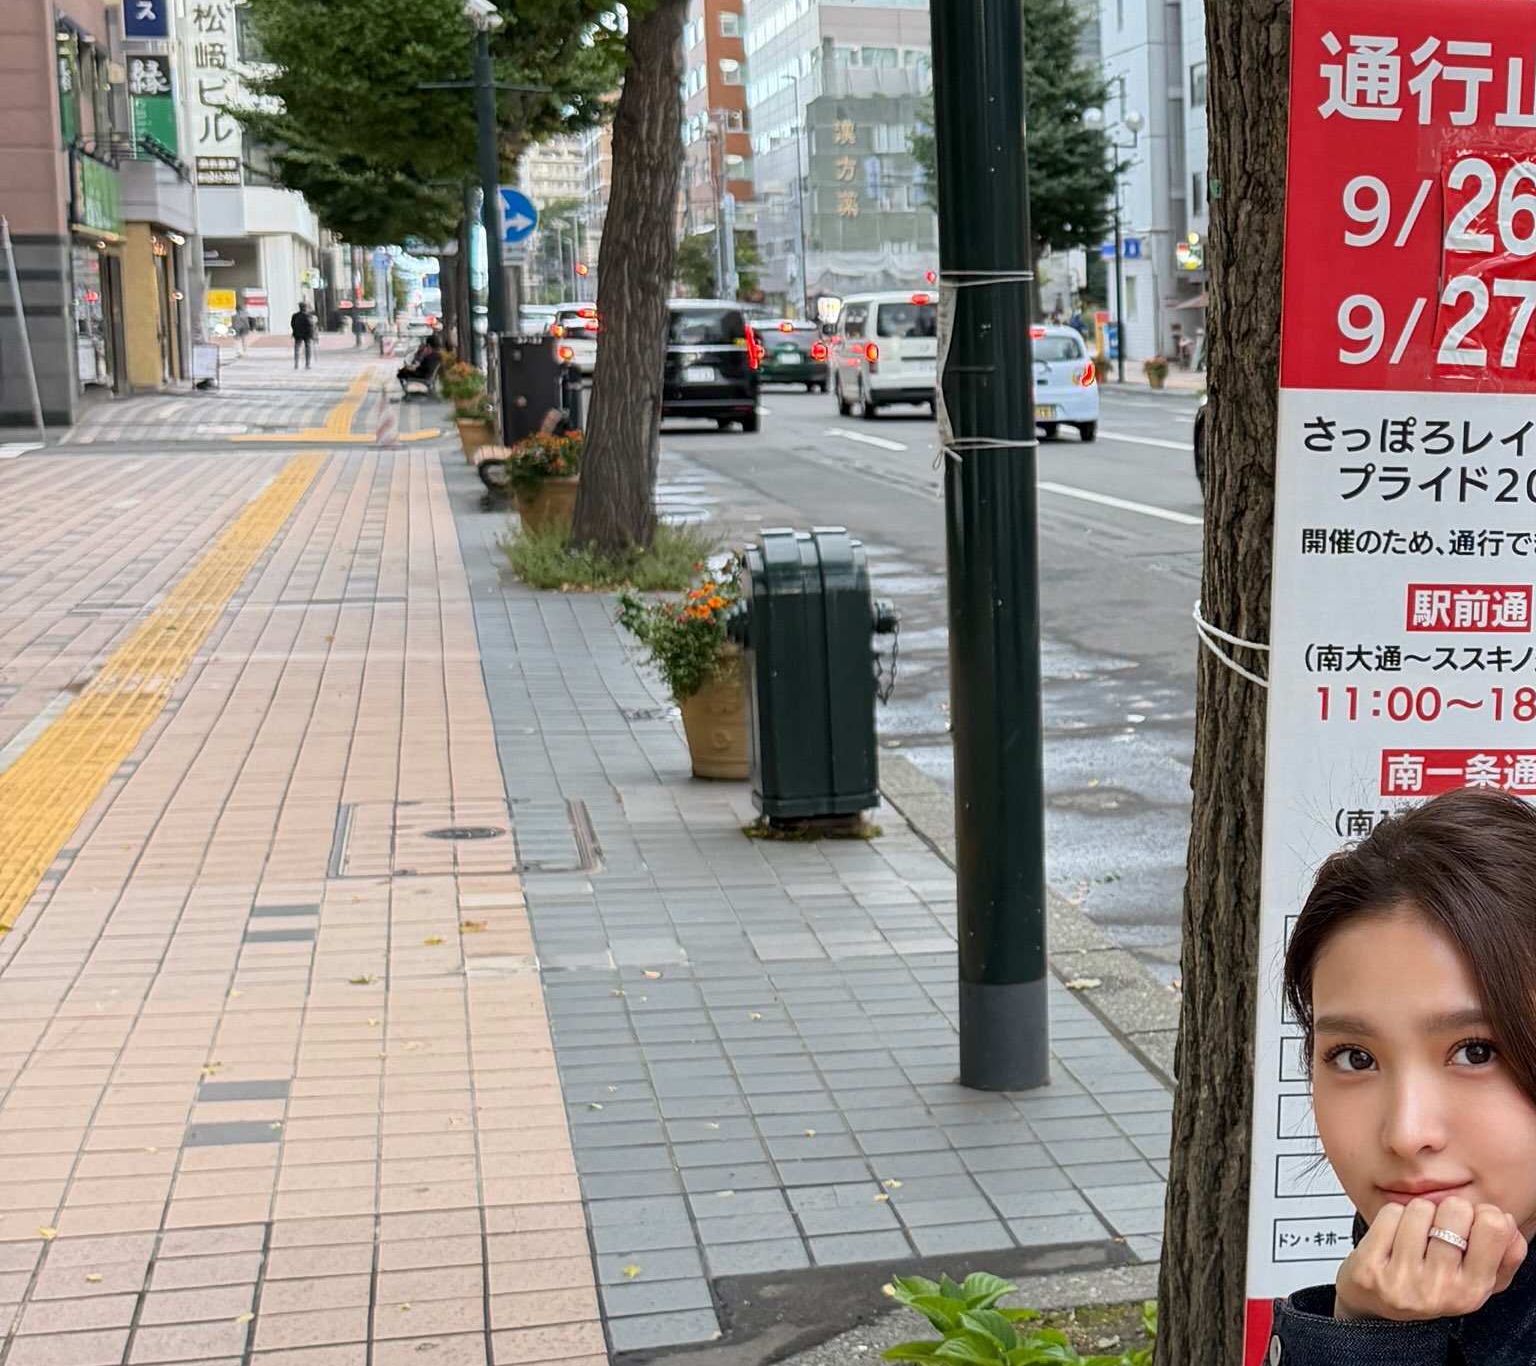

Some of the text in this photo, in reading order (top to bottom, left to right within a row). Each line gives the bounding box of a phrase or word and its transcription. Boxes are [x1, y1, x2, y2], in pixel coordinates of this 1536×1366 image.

[1412, 589, 1528, 628] 駅前通
[1279, 1231, 1353, 1248] ドン・キホー
